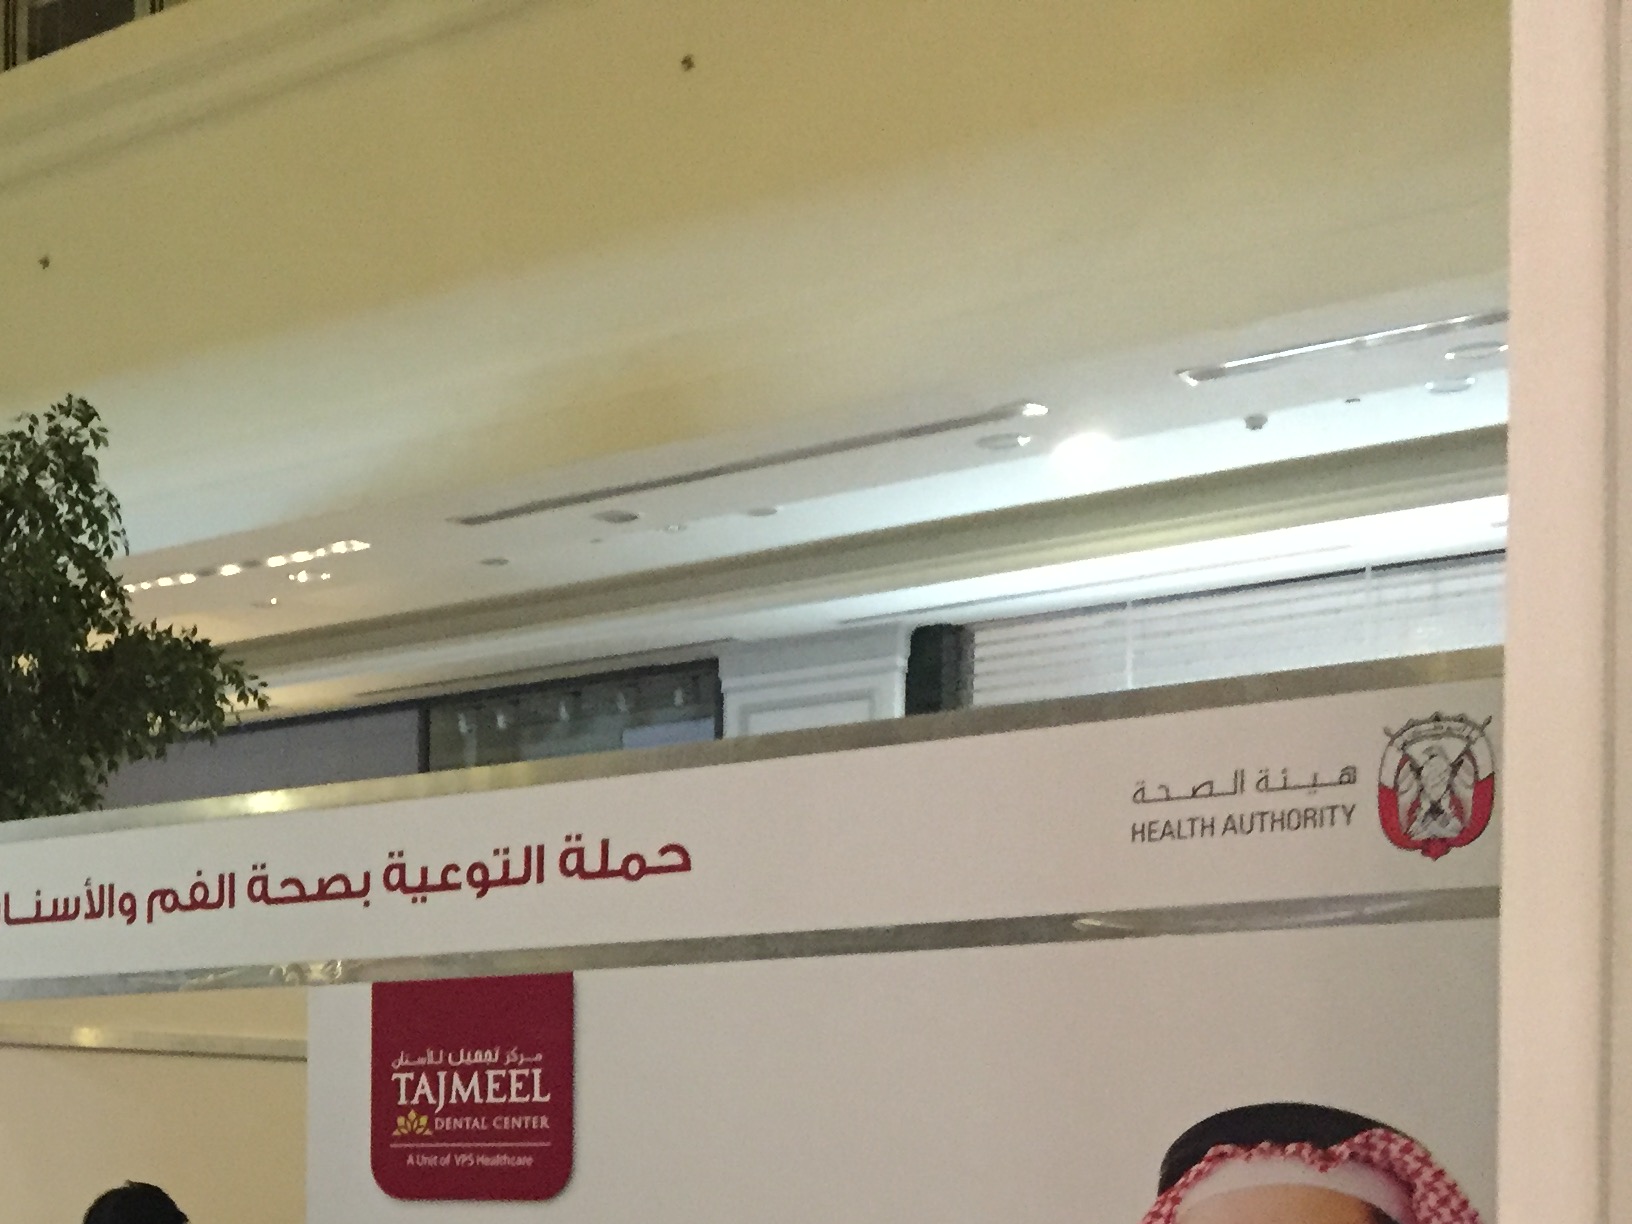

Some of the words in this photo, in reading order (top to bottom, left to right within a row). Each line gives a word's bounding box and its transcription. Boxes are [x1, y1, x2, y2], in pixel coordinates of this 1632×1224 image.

[1132, 768, 1245, 804] الصحة
[1256, 765, 1358, 796] هيئة
[1131, 814, 1216, 843] HEALTH
[1221, 803, 1357, 836] AUTHORITY
[382, 845, 545, 905] التوعية
[558, 832, 693, 883] حملة
[146, 869, 237, 925] الفم
[246, 861, 372, 909] بصحة
[391, 1068, 552, 1114] TAJMEEL
[434, 1115, 488, 1131] DENTAL
[492, 1114, 550, 1130] CENTER
